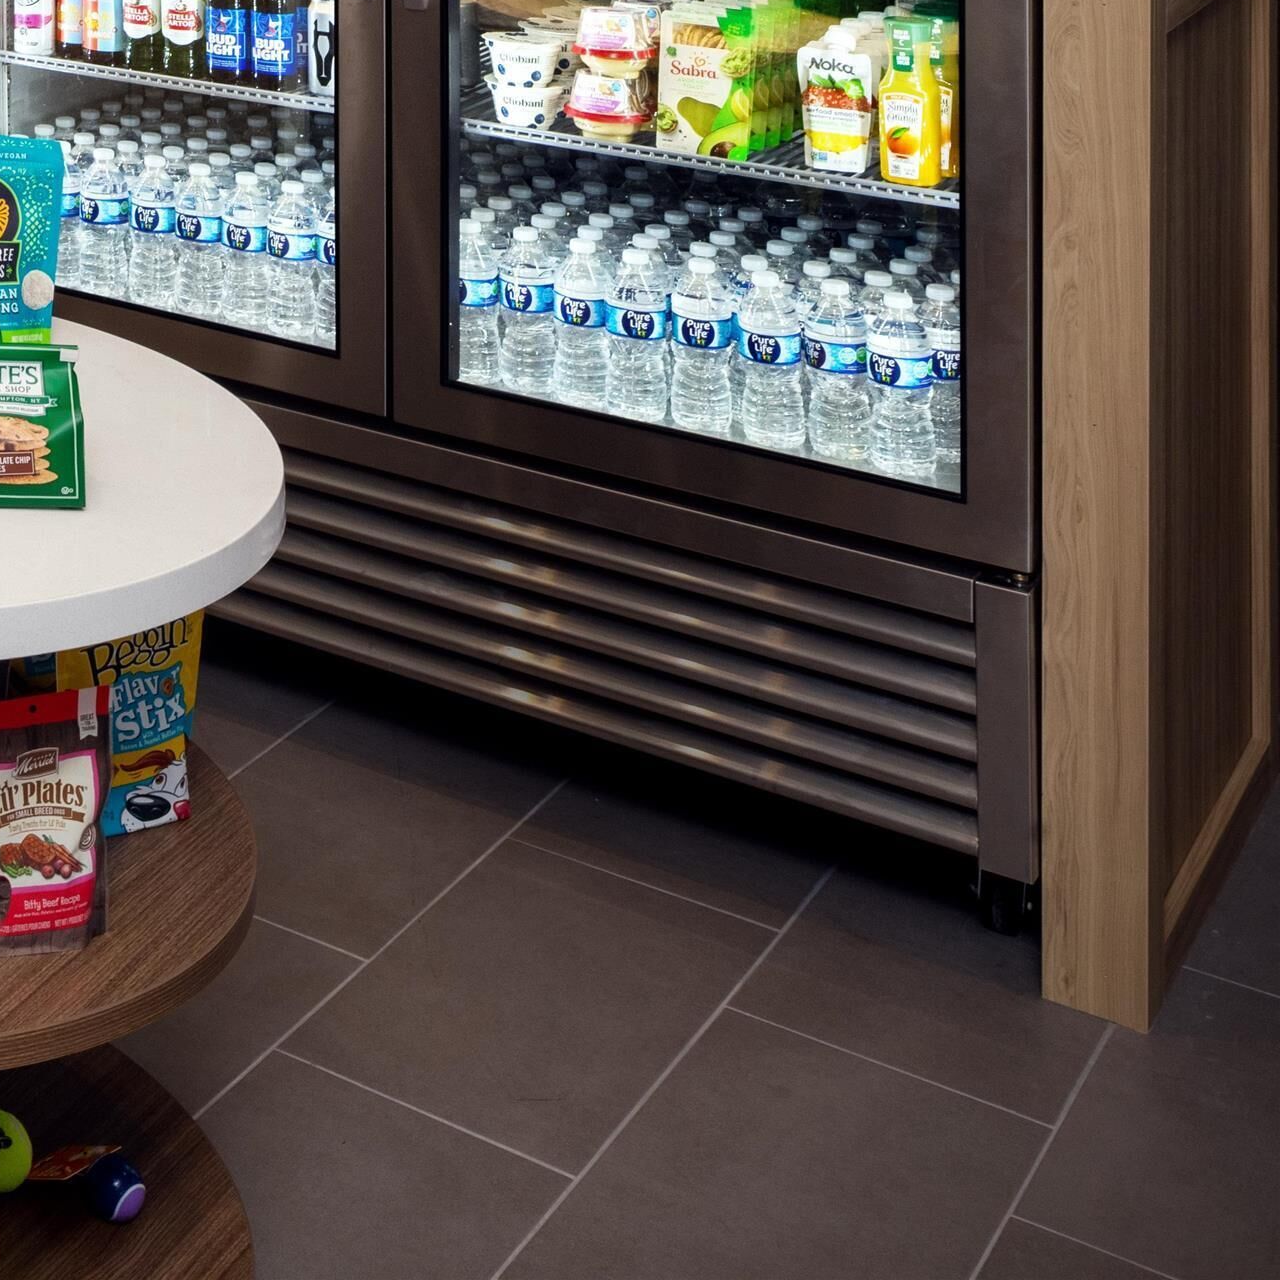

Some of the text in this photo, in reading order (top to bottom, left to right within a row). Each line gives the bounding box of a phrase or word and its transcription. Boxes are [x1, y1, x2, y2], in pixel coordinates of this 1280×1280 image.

[168, 13, 194, 22] STELLA
[255, 38, 285, 50] BUD
[252, 49, 290, 62] LIGHT
[670, 60, 717, 79] Sabra
[808, 56, 855, 76] Noka
[626, 310, 651, 323] Pure
[629, 320, 649, 332] Life
[686, 319, 710, 332] Pure
[688, 329, 709, 340] Life
[3, 385, 32, 393] SHOP
[15, 456, 31, 465] CHIP
[114, 692, 185, 743] Stix
[22, 779, 84, 807] Plates
[23, 893, 81, 912] Bitty Beef Recipe
